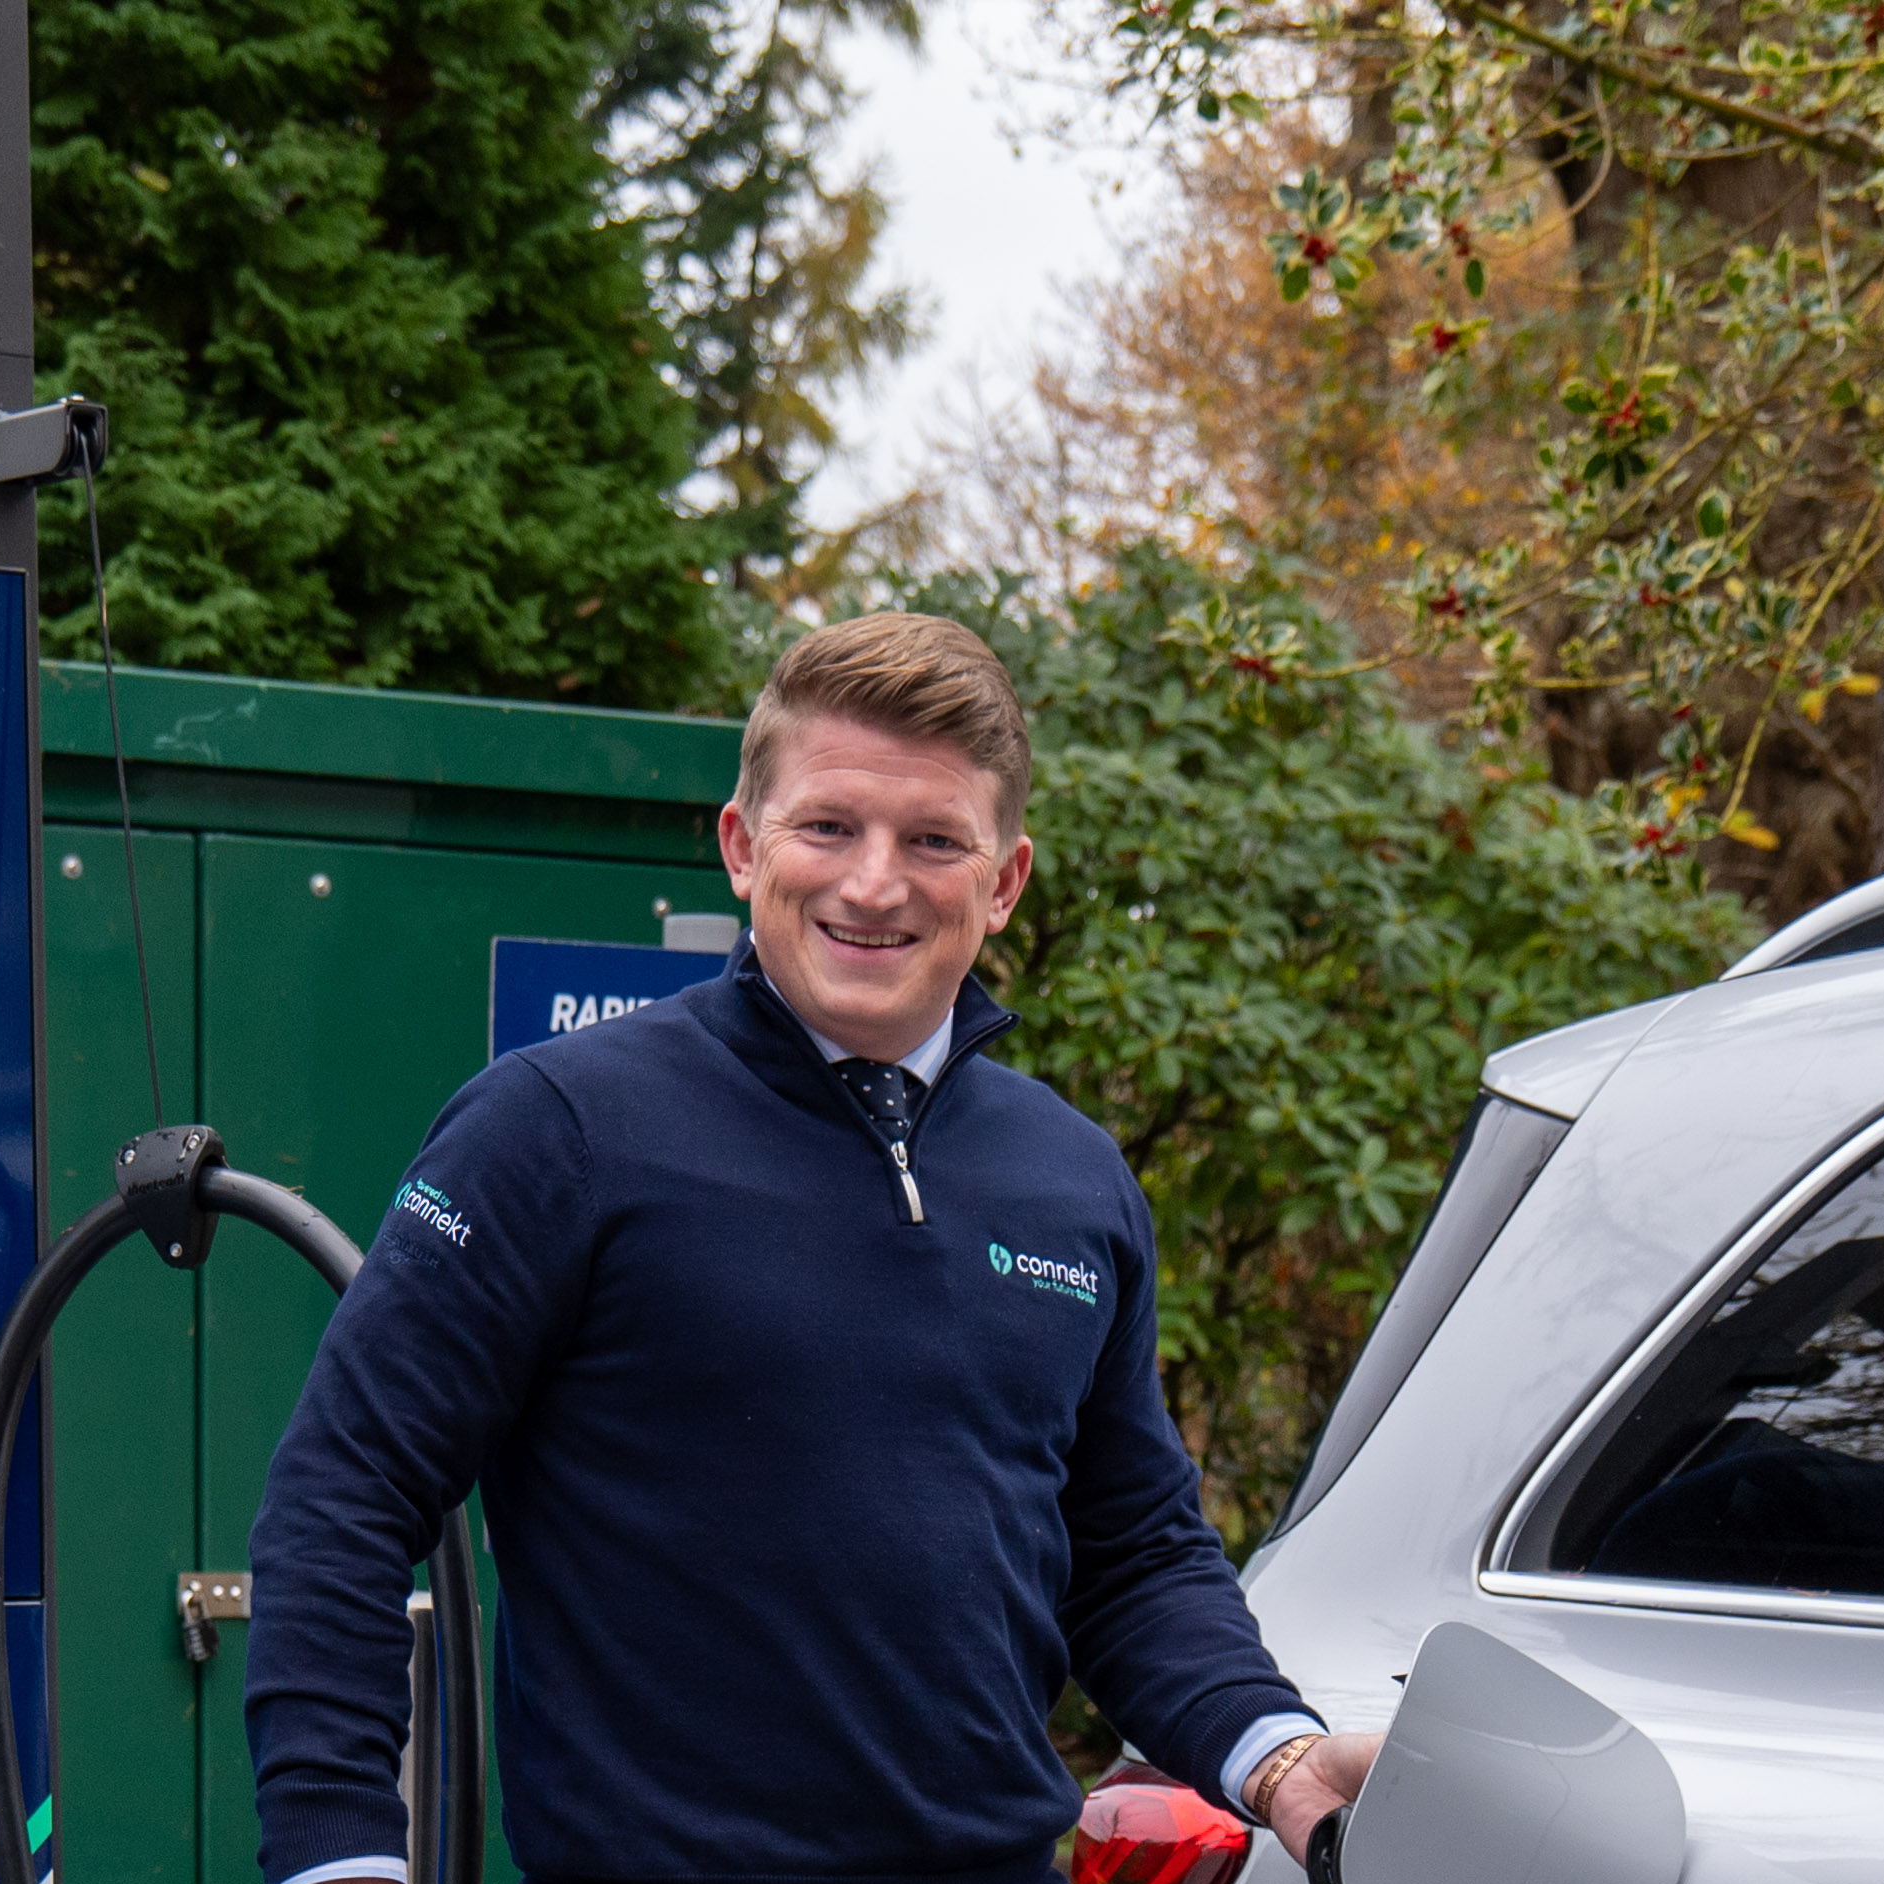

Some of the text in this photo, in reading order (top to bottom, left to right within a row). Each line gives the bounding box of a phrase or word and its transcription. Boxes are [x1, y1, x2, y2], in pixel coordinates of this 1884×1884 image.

[549, 993, 656, 1034] RAP
[403, 1189, 472, 1248] connekt
[1016, 1253, 1099, 1294] connekt
